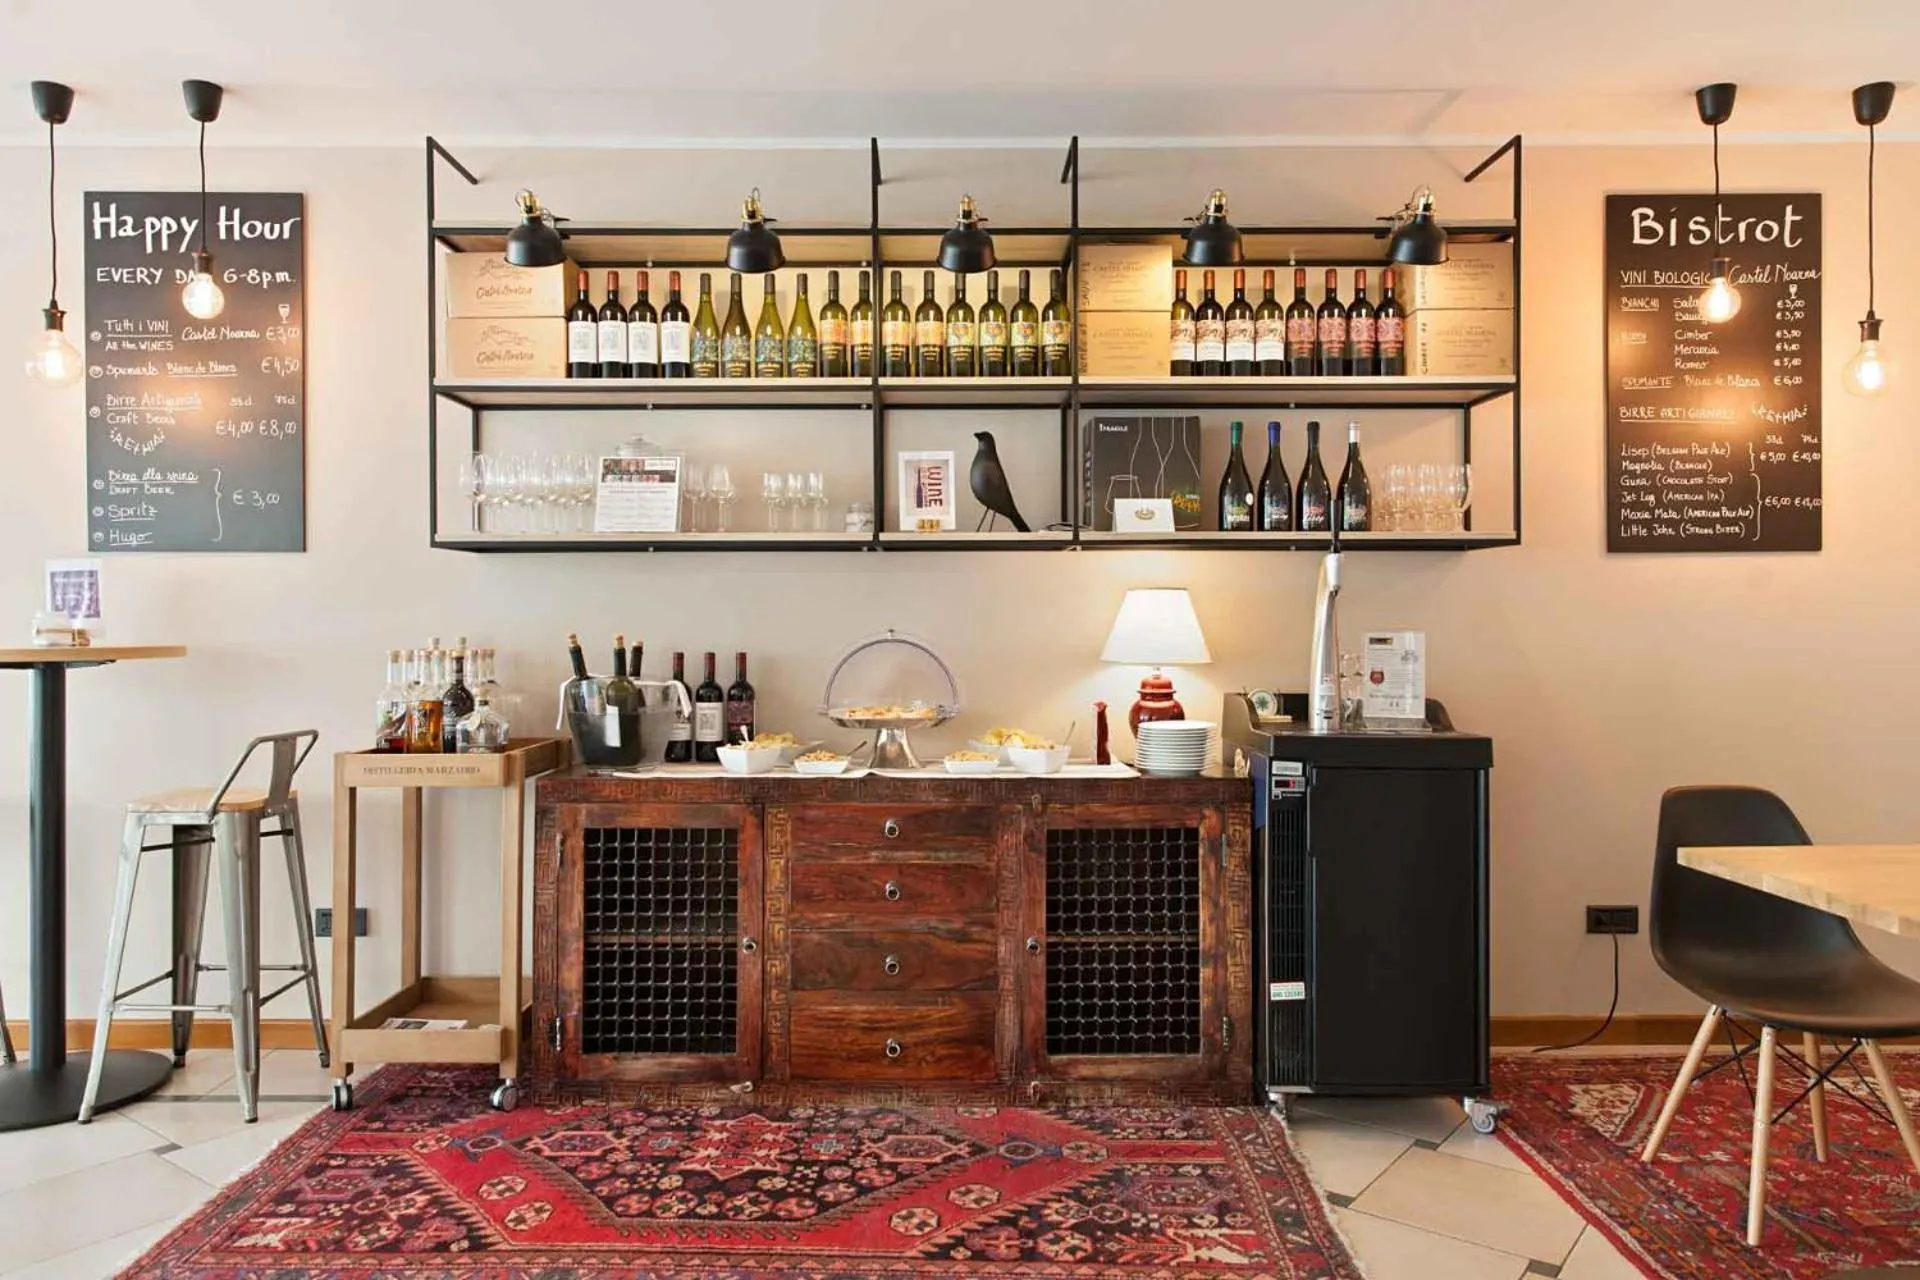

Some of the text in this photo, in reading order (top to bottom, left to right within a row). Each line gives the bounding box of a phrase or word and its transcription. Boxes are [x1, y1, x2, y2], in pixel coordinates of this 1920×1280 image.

[92, 201, 302, 254] Happy Hour
[1631, 204, 1803, 248] Bistrot
[96, 267, 163, 285] EVERY
[175, 268, 199, 284] DA
[1620, 270, 1646, 284] VINI
[1653, 270, 1712, 285] BIOLOGIC
[1728, 264, 1771, 287] Castel
[1620, 297, 1660, 309] BIANCHI
[147, 319, 169, 333] VINI
[265, 326, 300, 344] €3,00
[139, 340, 174, 352] WINES
[261, 356, 300, 377] €4,50
[1674, 357, 1710, 370] Romeo
[107, 411, 139, 424] Craft
[1619, 406, 1656, 419] BIRRE
[216, 418, 297, 441] €4,00 €8,00
[1621, 491, 1637, 504] Jet
[1764, 496, 1791, 508] €6,00
[108, 501, 158, 520] Spritz
[109, 528, 153, 547] Hugo
[1621, 523, 1649, 537] Little
[1652, 523, 1676, 536] John
